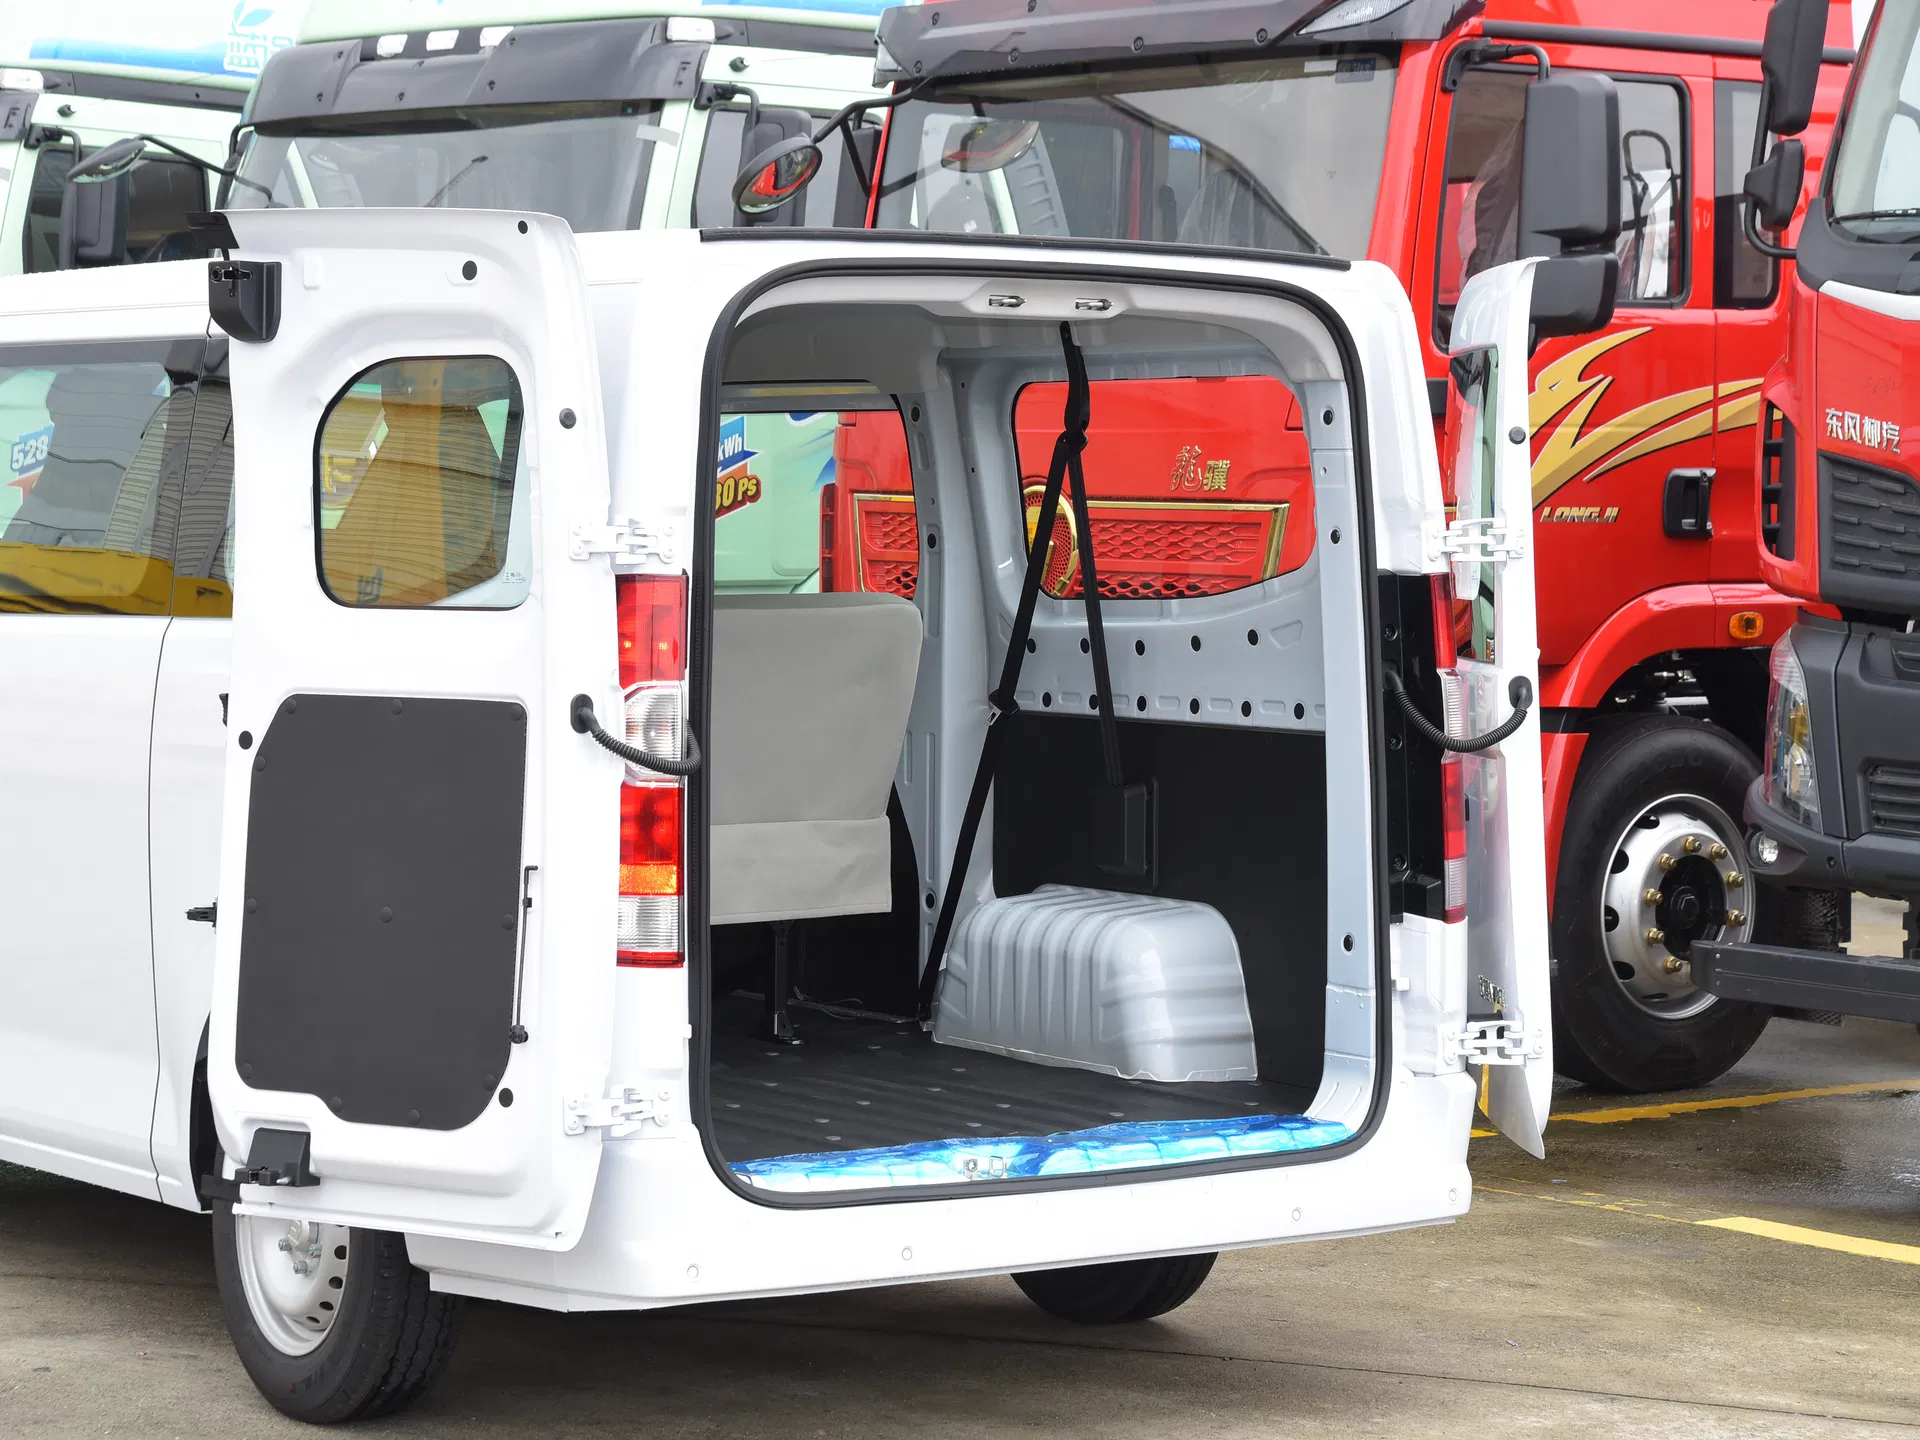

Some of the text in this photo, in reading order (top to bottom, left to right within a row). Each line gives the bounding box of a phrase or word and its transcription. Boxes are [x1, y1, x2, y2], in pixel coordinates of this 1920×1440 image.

[1825, 408, 1901, 454] 东风柳汽
[12, 435, 49, 470] 528
